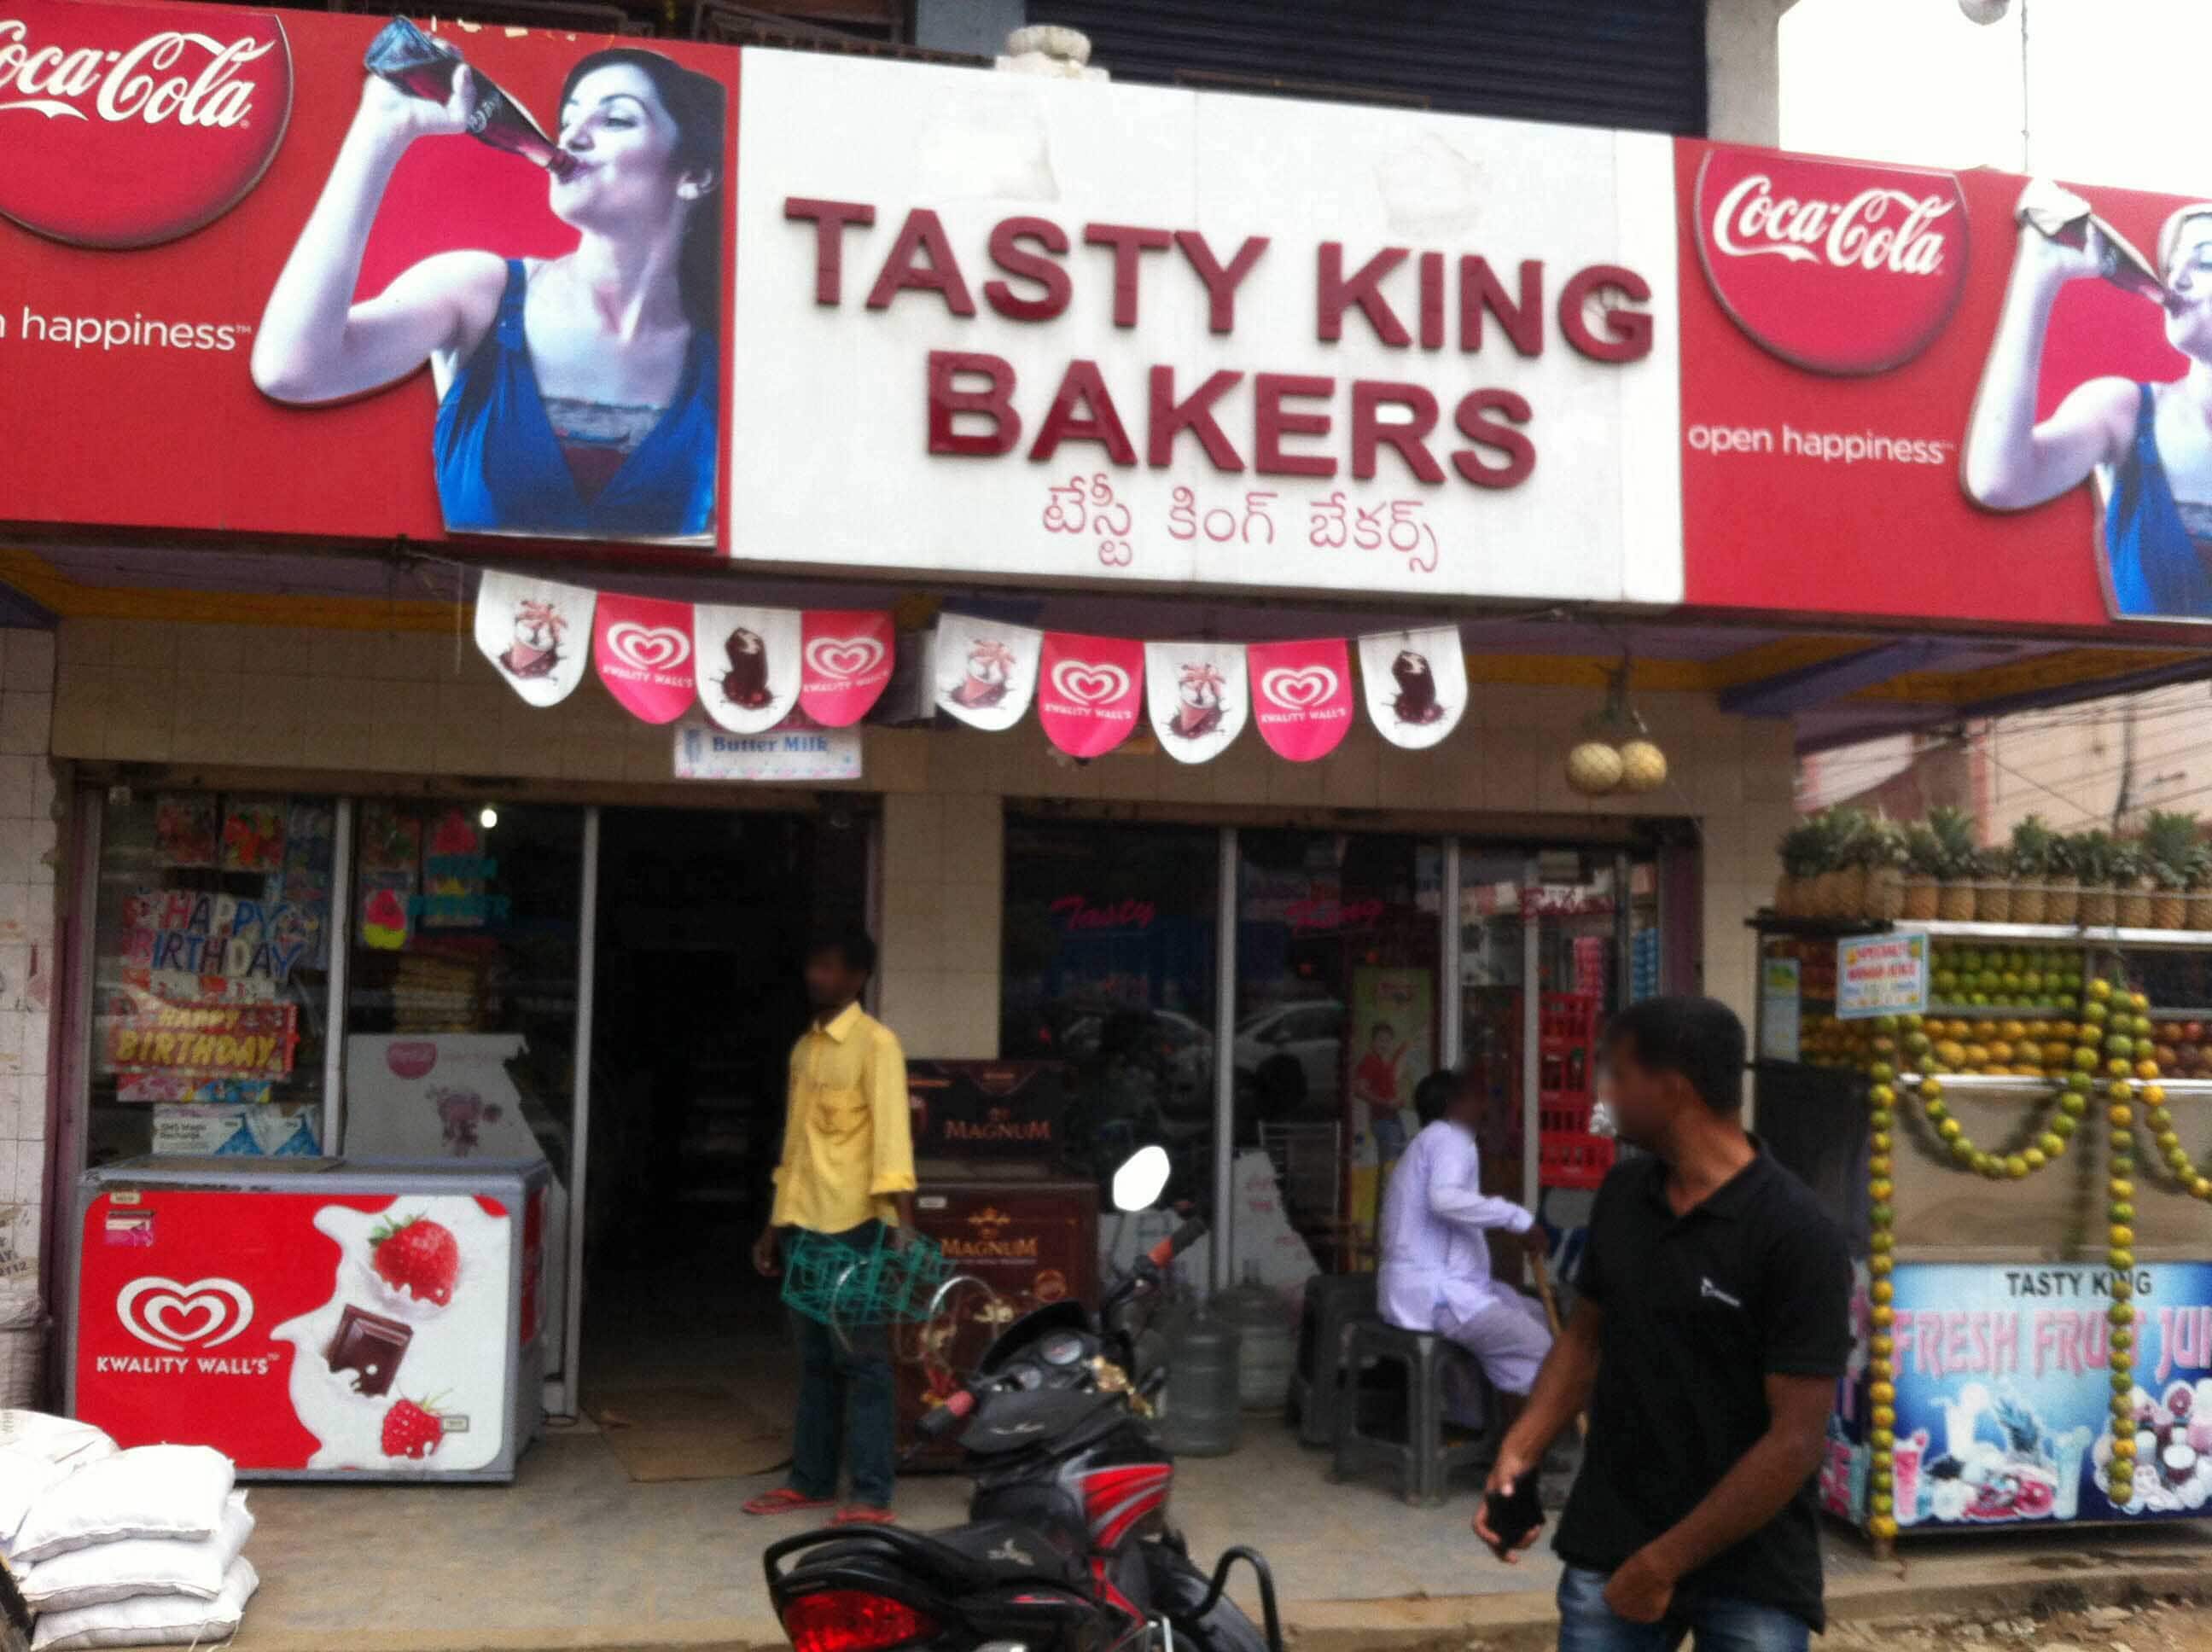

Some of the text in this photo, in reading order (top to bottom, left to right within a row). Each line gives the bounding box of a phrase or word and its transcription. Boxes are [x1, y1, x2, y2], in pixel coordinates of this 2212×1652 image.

[1712, 174, 1957, 275] Coca-Cola
[783, 195, 1656, 365] TASTY KING
[21, 305, 236, 351] happiness
[927, 349, 1538, 492] BAKERS
[1688, 424, 1946, 465] open happiness
[712, 736, 777, 753] Butter
[784, 736, 828, 752] Milk
[115, 1029, 277, 1067] BIRTHDAY
[945, 1120, 1051, 1140] MAGNUM
[941, 1237, 1039, 1257] MAGNUM
[2006, 1272, 2083, 1297] TASTY
[1890, 1309, 2020, 1381] FRESH
[2034, 1307, 2146, 1379] FRUT
[96, 1355, 270, 1376] KWALITY WALL'S
